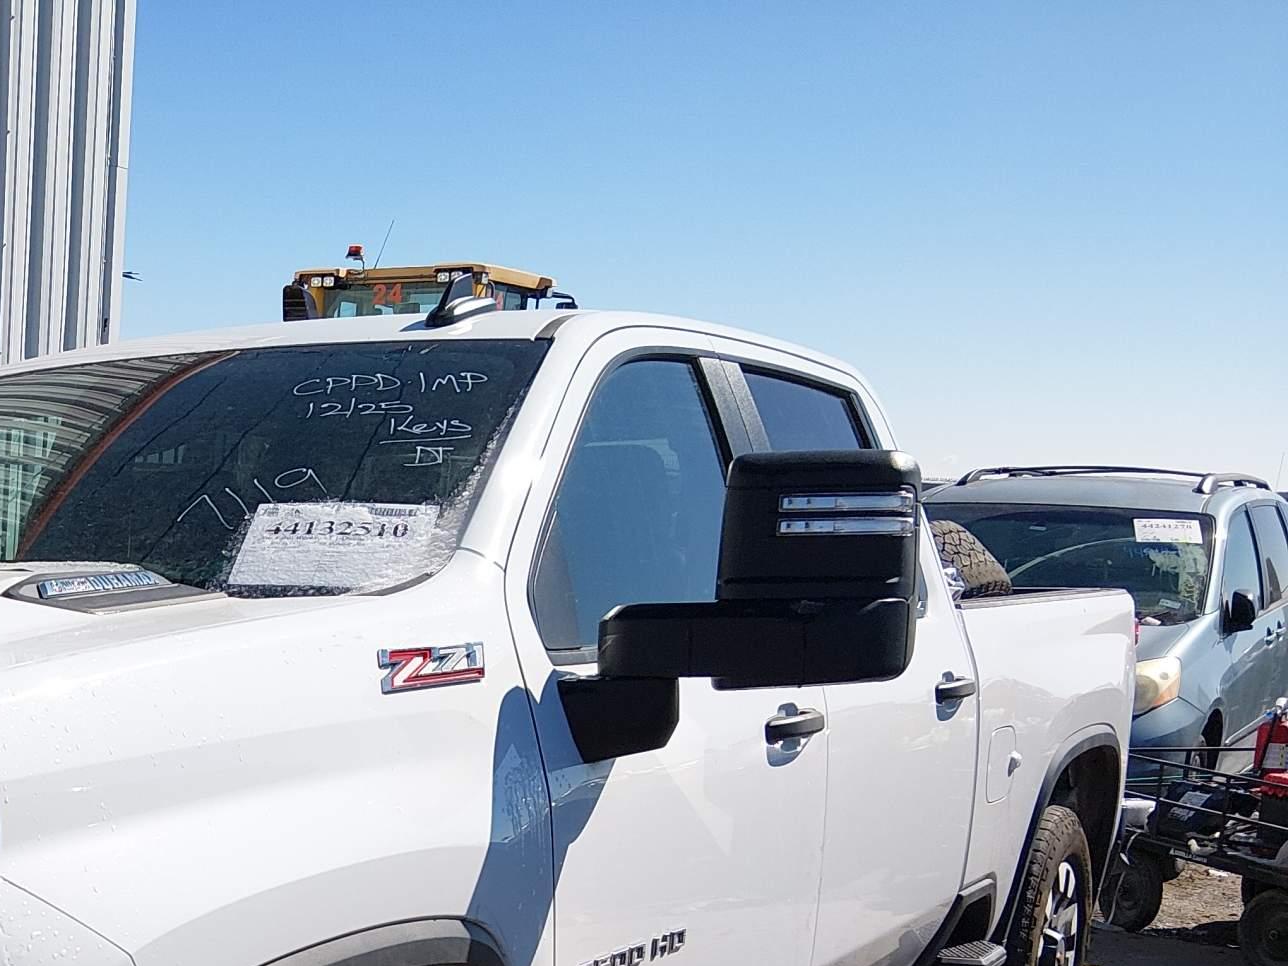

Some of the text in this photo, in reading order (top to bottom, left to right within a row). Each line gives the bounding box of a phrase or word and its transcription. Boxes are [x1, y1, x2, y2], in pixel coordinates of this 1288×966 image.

[372, 283, 402, 304] 24
[306, 398, 414, 419] 12/25
[389, 417, 473, 436] Keys
[264, 520, 409, 538] 44132510
[376, 641, 485, 695] Z71
[649, 927, 687, 962] HD
